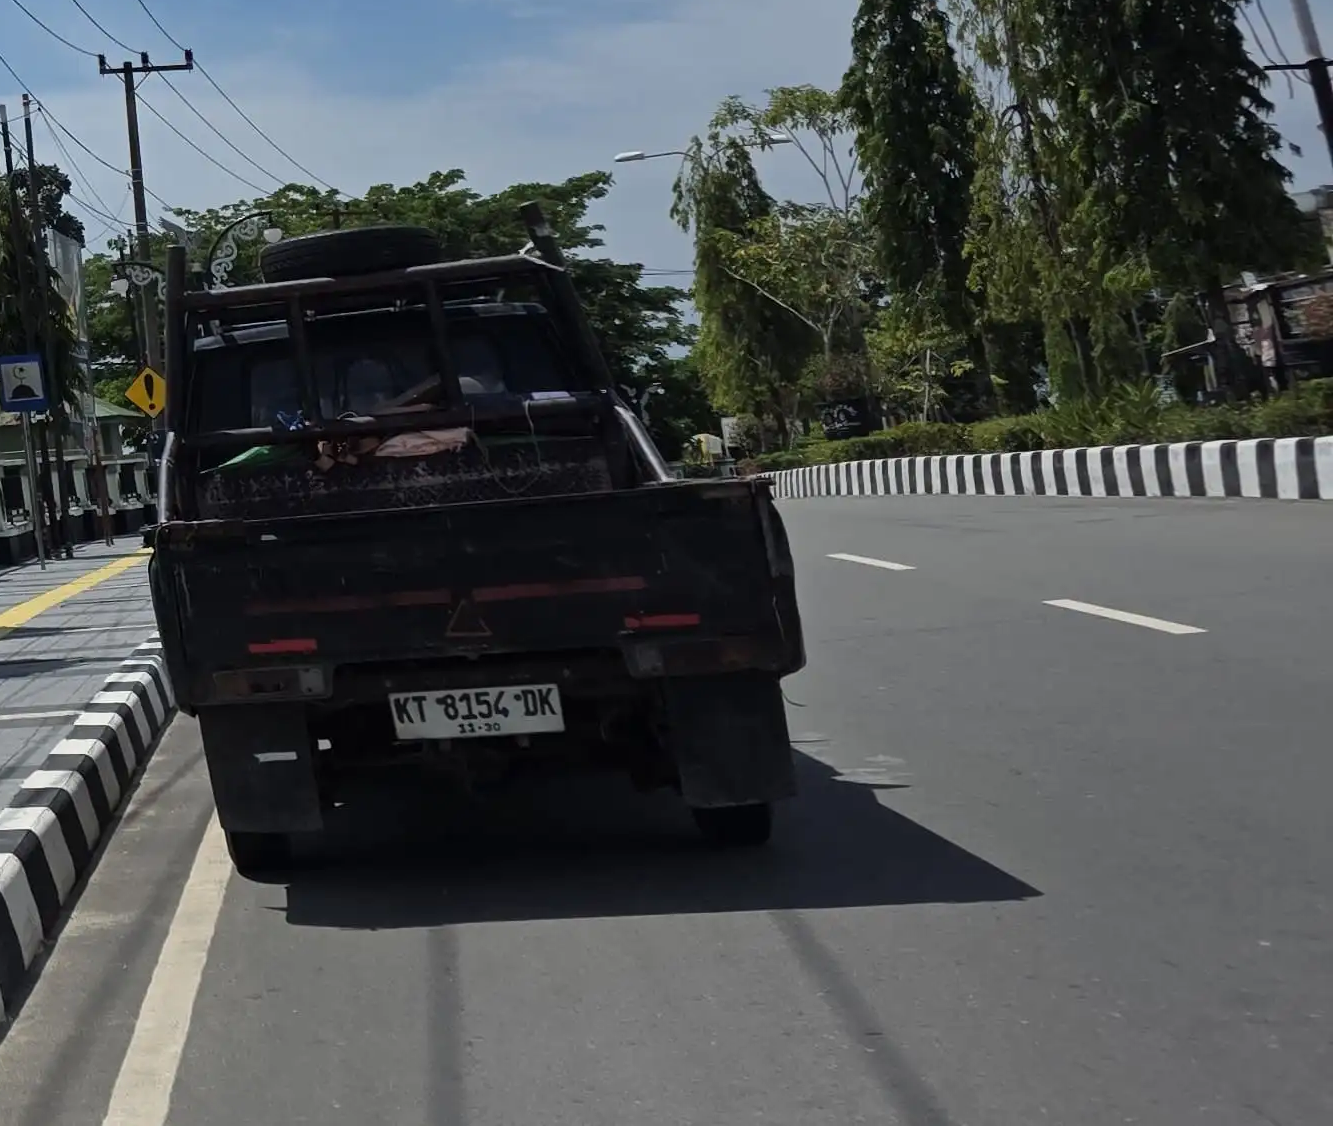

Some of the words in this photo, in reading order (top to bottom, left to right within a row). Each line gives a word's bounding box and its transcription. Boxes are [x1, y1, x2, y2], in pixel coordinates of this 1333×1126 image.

[394, 696, 427, 724] KT
[441, 691, 509, 720] 8154
[521, 688, 557, 716] DK
